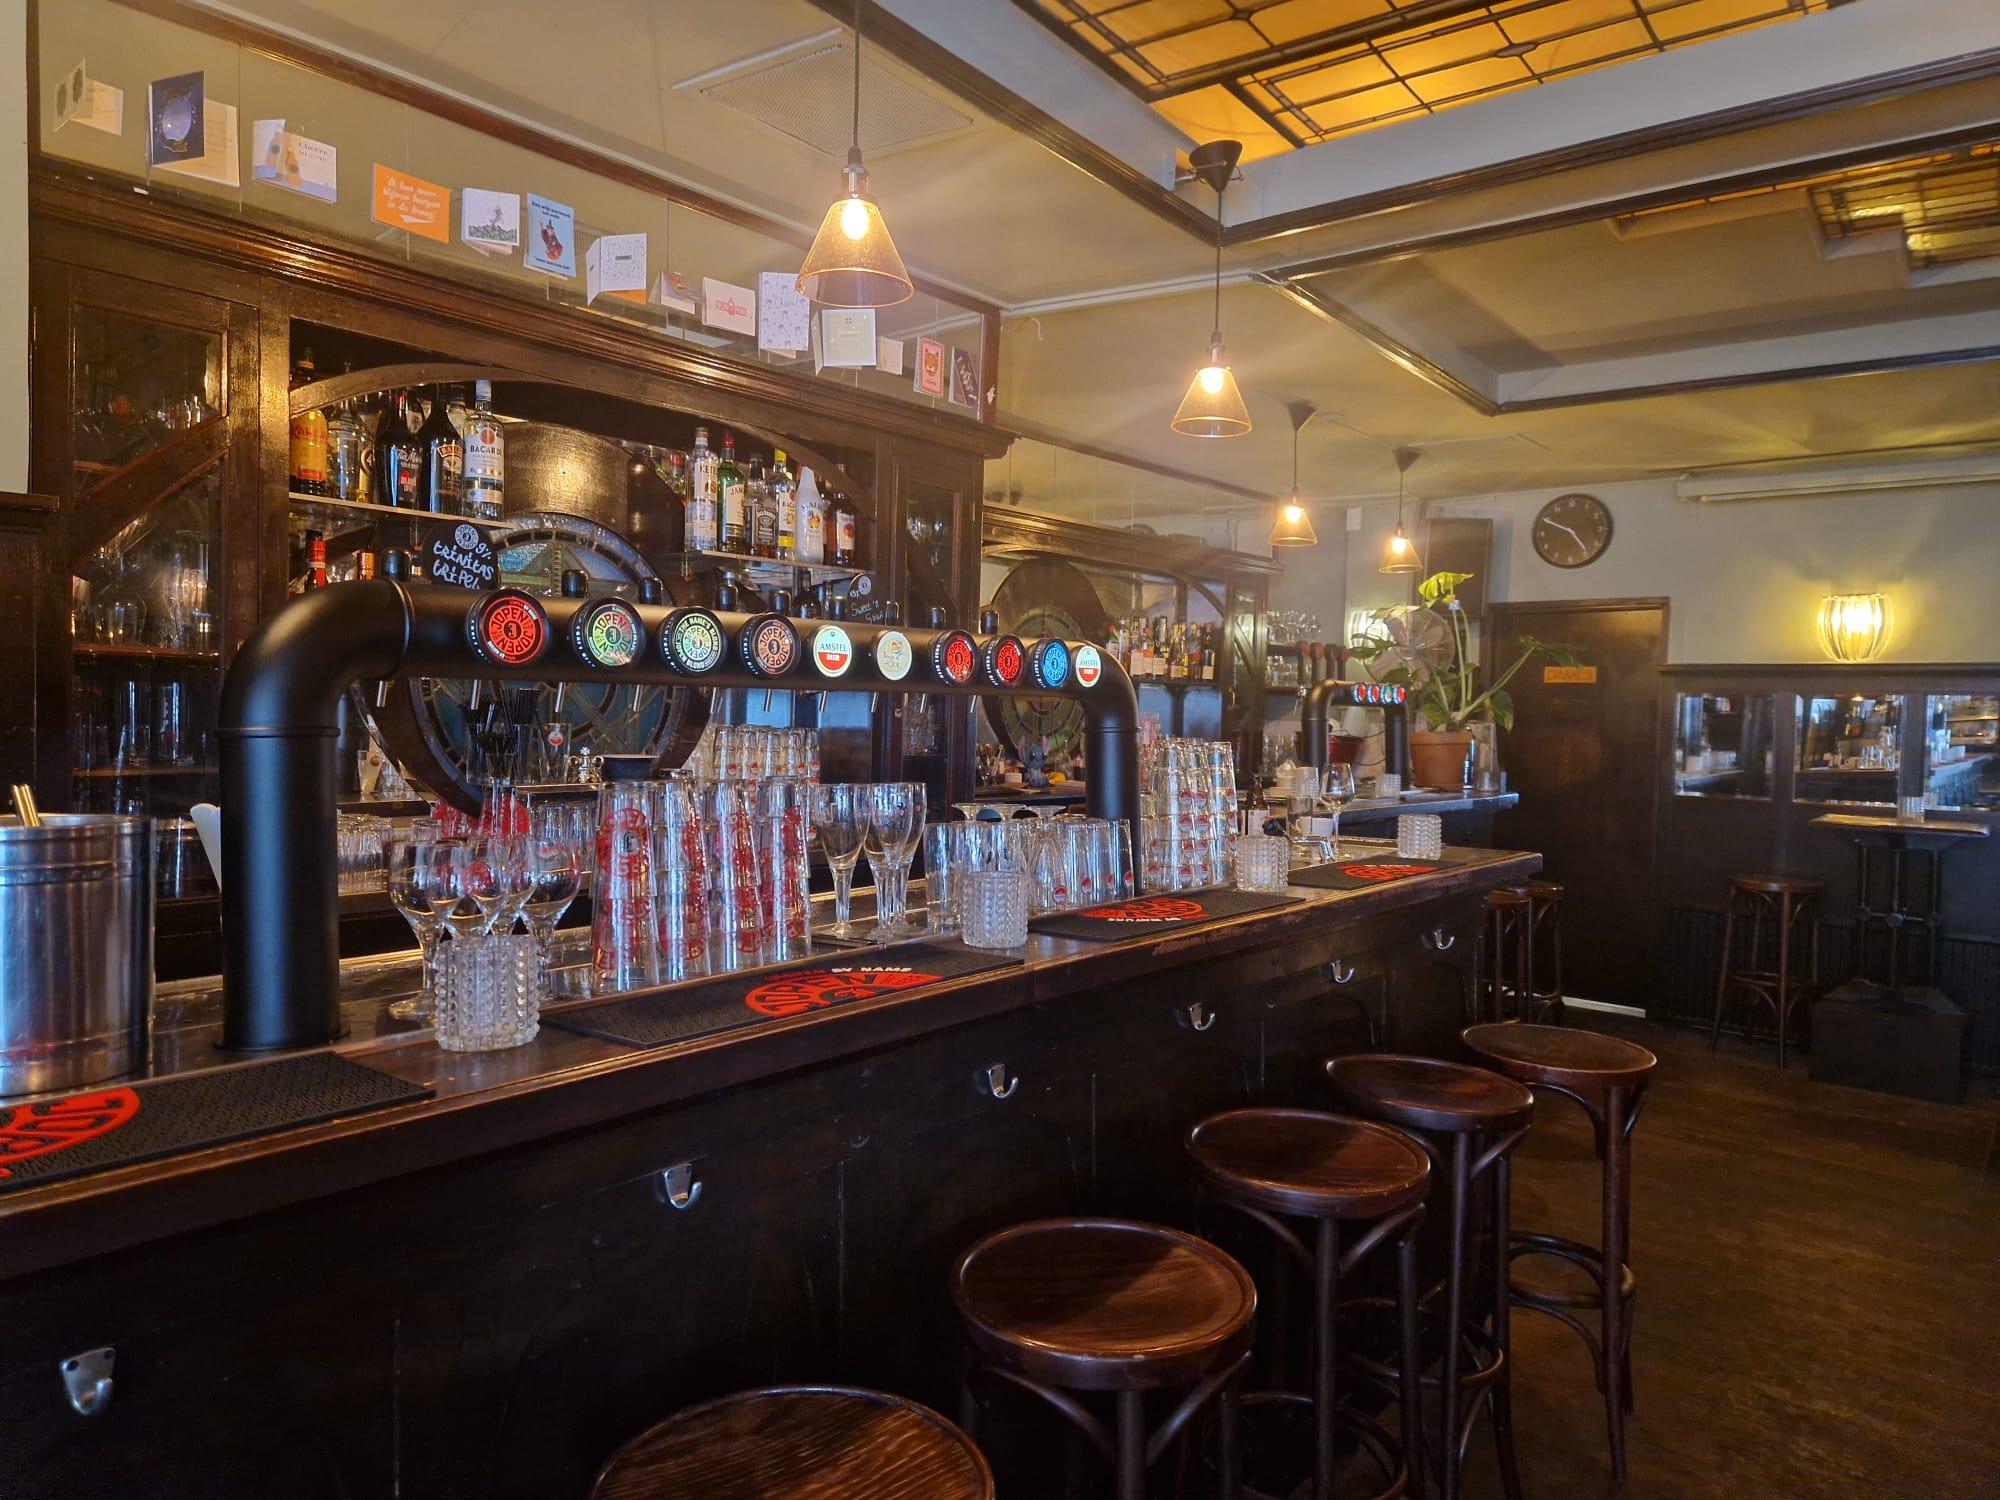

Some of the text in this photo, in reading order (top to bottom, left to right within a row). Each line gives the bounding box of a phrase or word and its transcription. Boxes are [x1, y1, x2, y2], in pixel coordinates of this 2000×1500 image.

[490, 606, 529, 631] JOPEN
[594, 613, 628, 635] JOPEN
[760, 628, 786, 646] JOPEN
[819, 642, 848, 652] AMSTEL
[1079, 659, 1099, 668] AMSTEL
